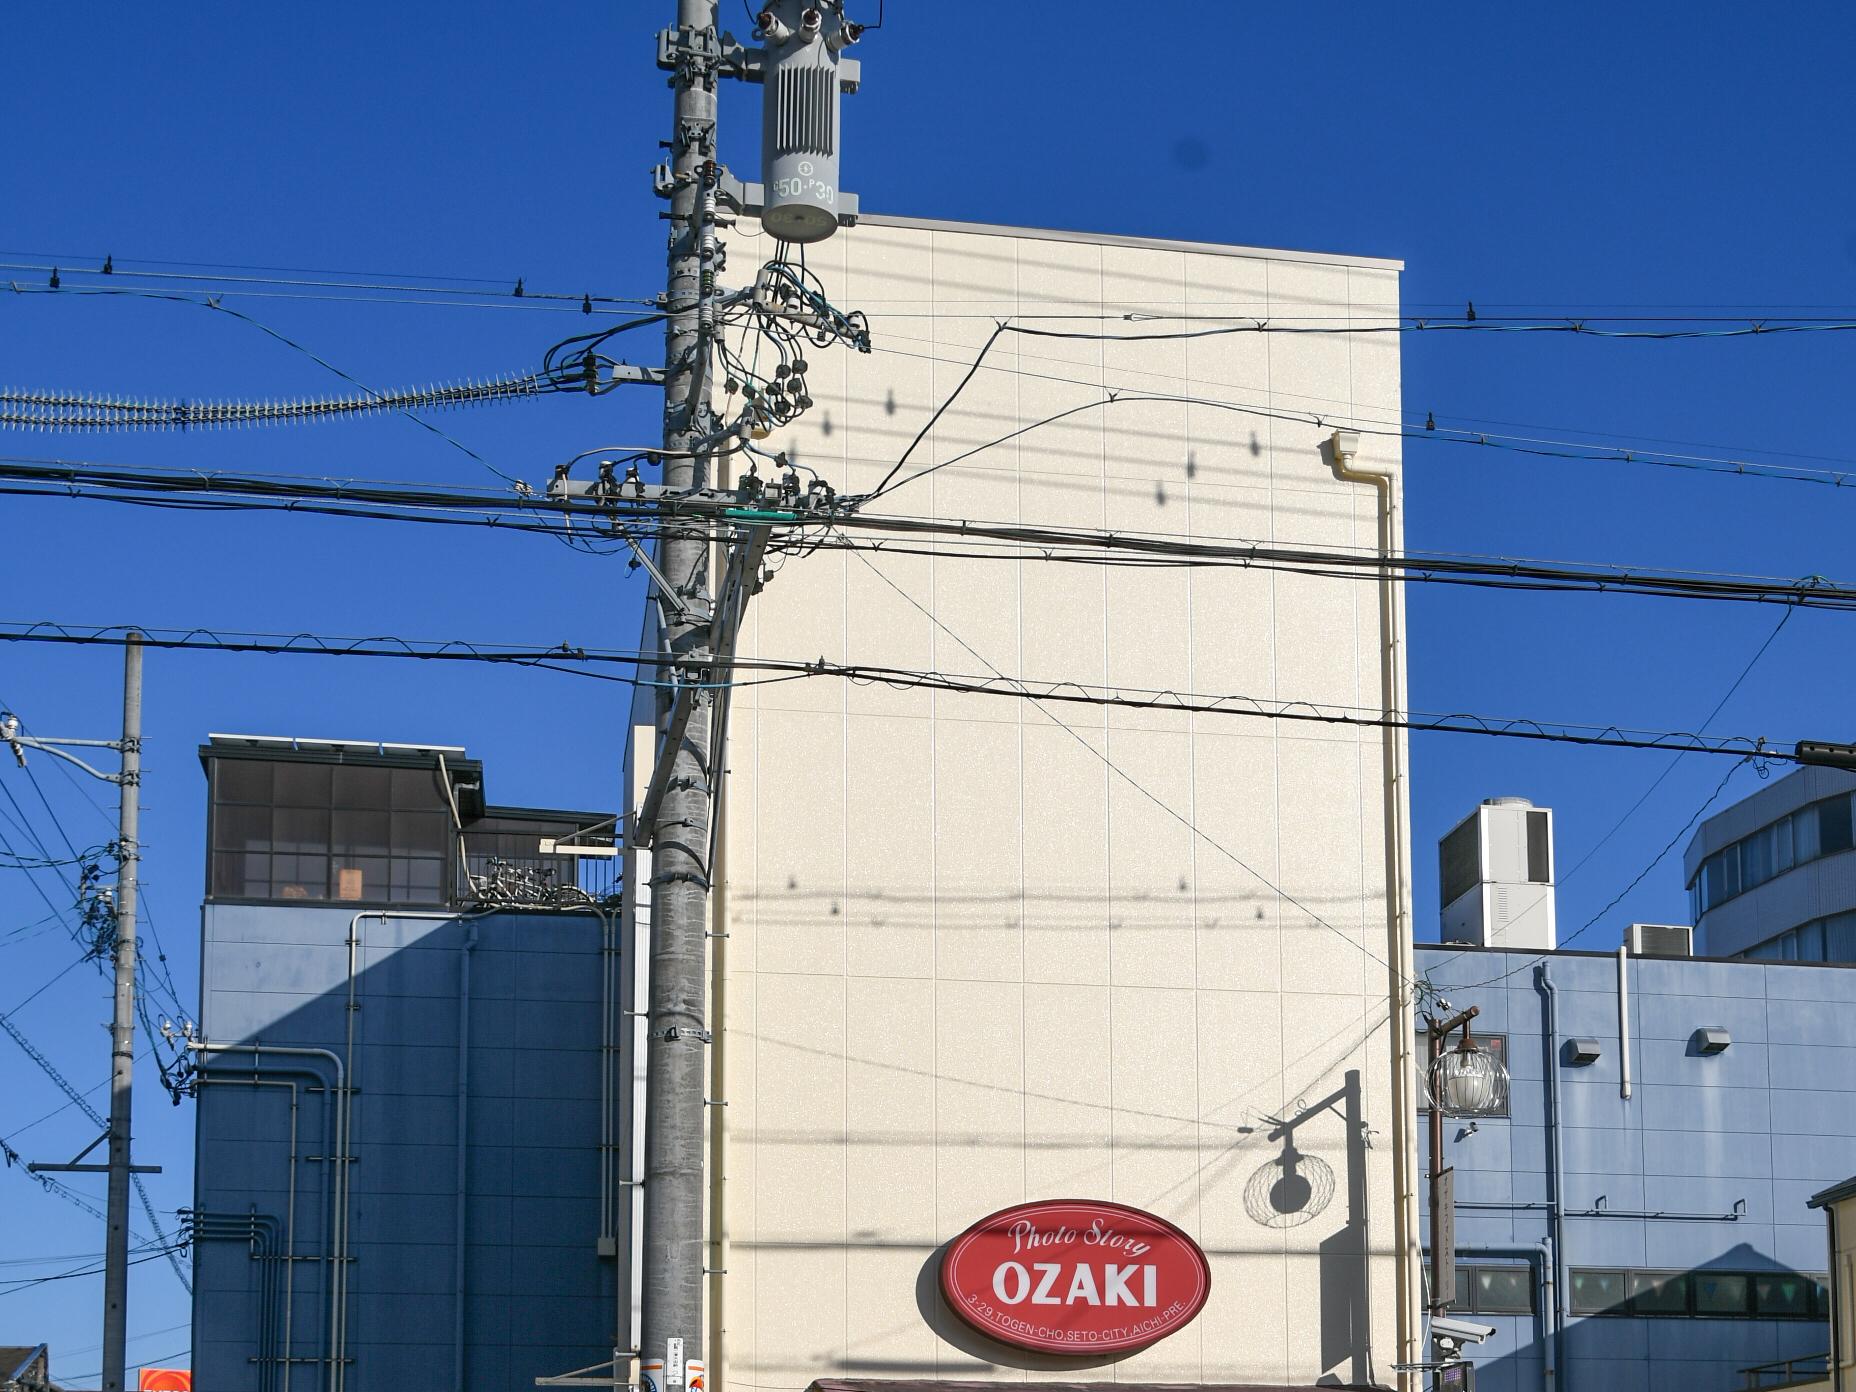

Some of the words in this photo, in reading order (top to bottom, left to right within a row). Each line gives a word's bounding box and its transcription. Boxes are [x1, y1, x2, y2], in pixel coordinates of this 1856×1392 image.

[1008, 1220, 1077, 1255] Photo
[1083, 1218, 1151, 1257] Story
[992, 1261, 1157, 1307] OZAKI
